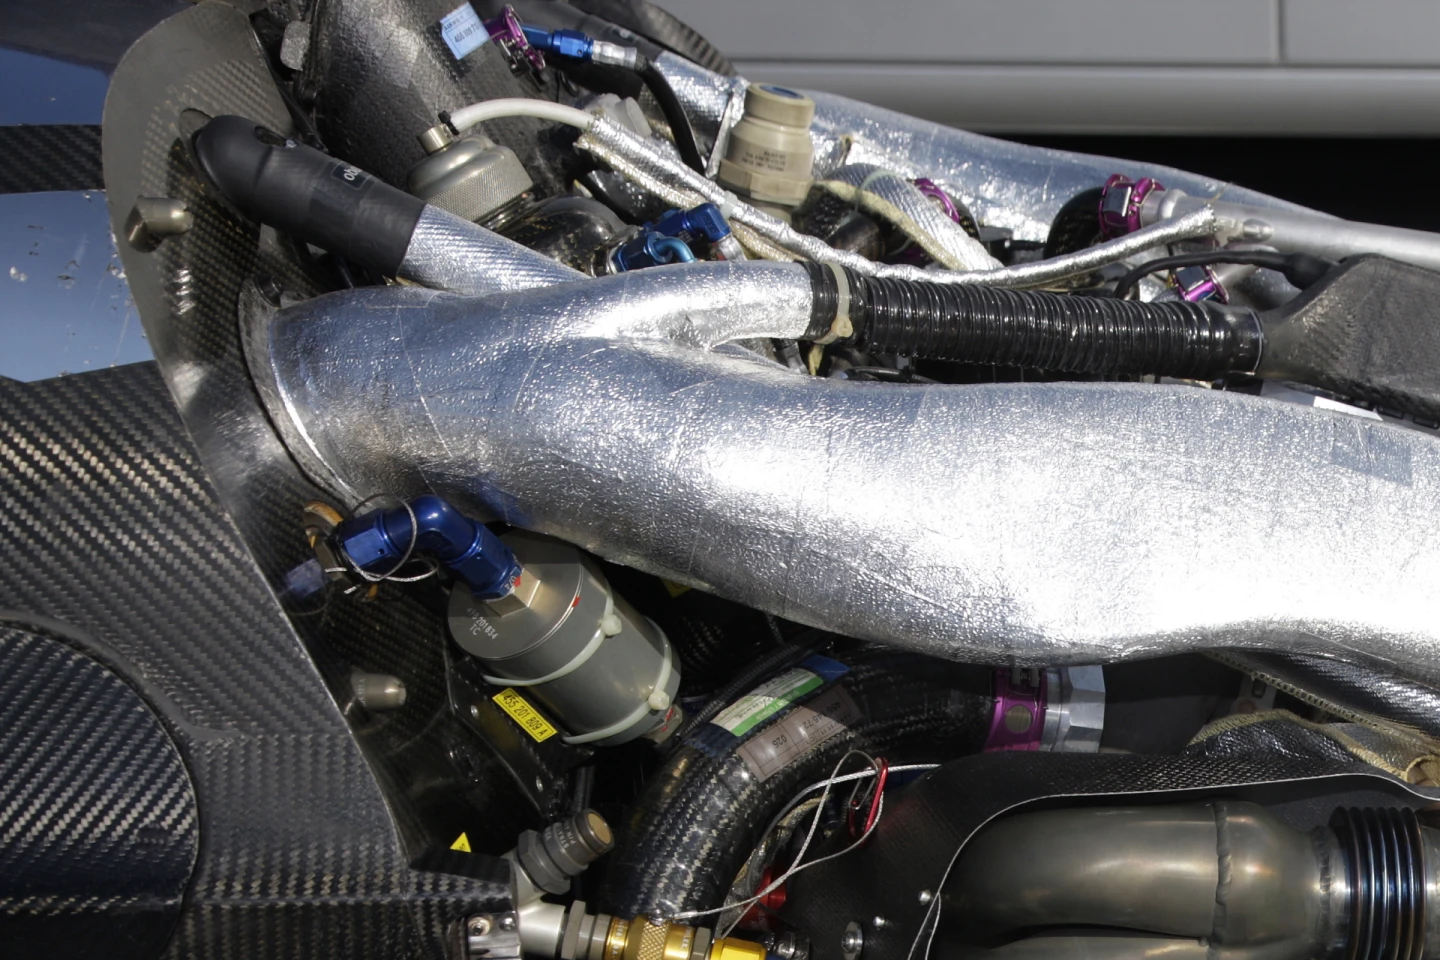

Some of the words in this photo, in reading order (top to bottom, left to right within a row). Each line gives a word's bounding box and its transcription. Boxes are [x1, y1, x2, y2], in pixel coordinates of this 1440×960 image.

[469, 623, 482, 636] TC
[503, 694, 520, 708] 455
[513, 705, 530, 719] 201
[525, 716, 543, 731] 809
[537, 729, 548, 737] A
